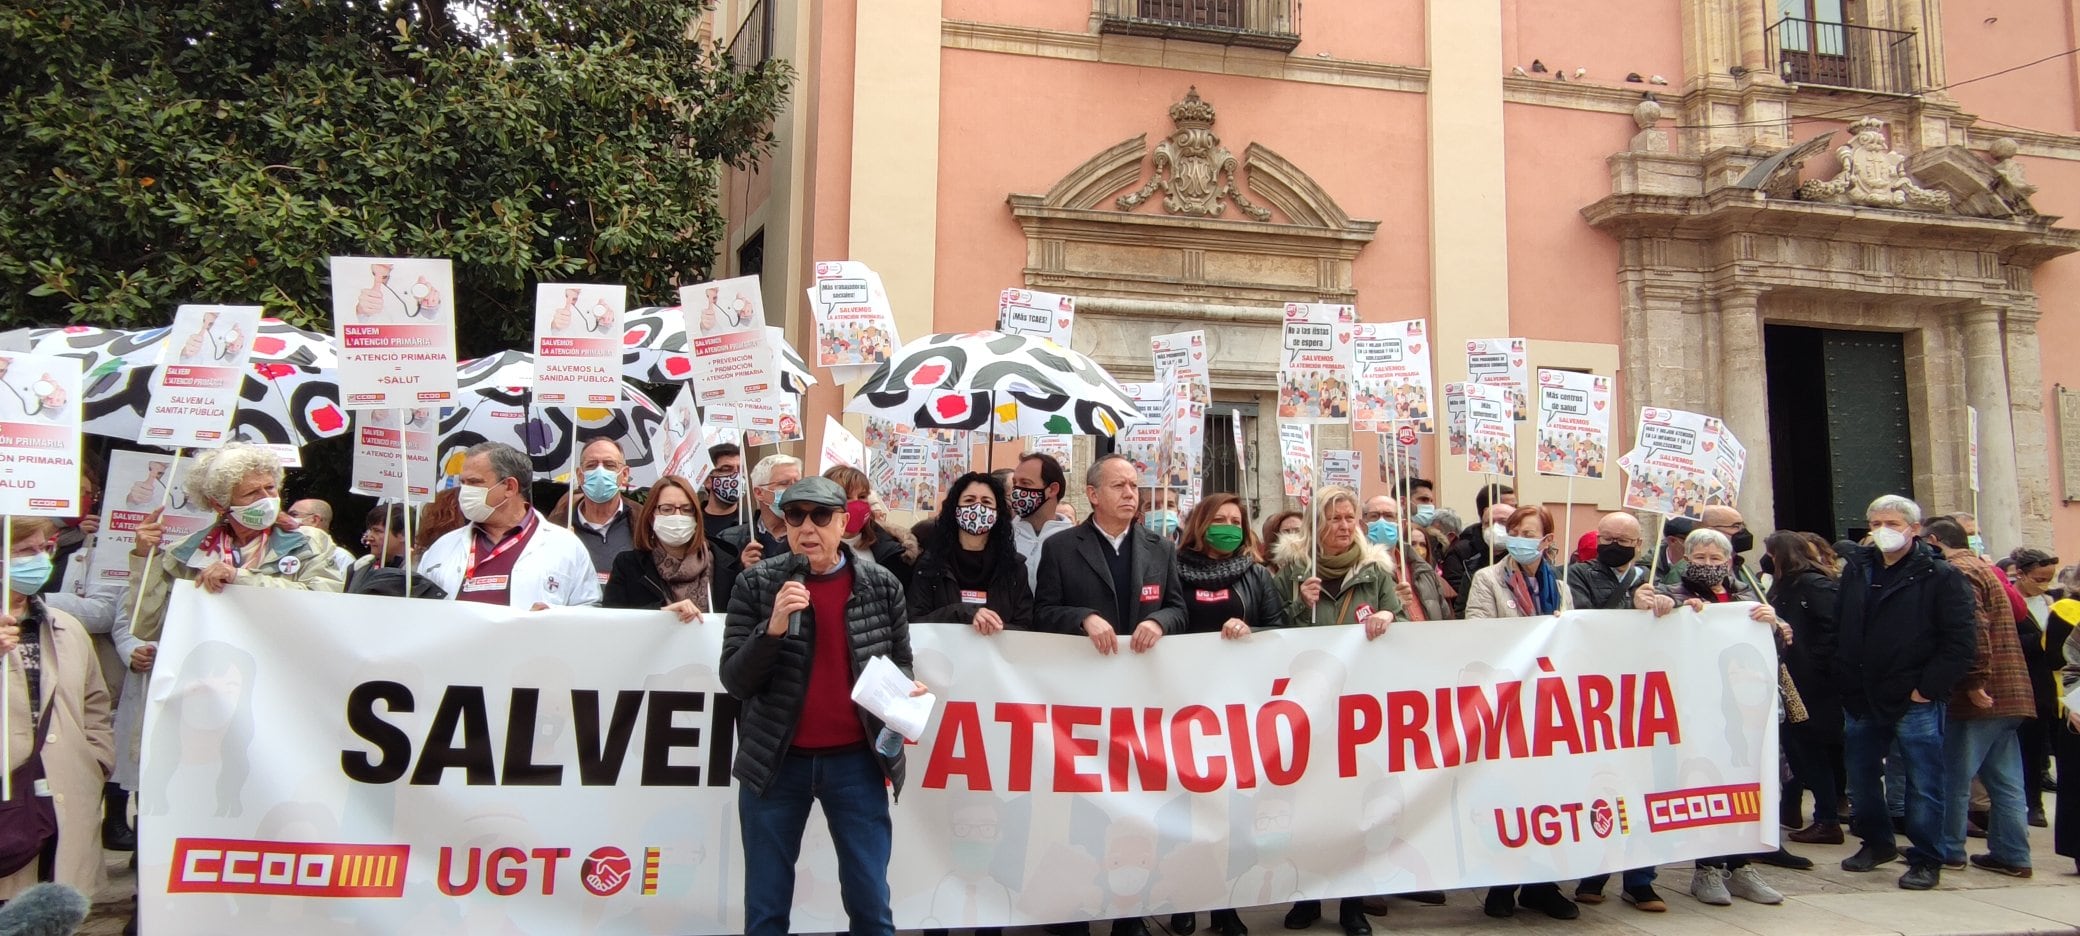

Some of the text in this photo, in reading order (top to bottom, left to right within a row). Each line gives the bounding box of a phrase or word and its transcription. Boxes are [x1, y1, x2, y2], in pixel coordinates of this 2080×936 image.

[1288, 326, 1295, 334] No
[1302, 327, 1311, 335] las
[1312, 327, 1329, 336] listas
[1302, 340, 1323, 348] espera
[1302, 354, 1334, 362] SALVEMOS
[546, 365, 592, 373] SALVEMOS
[170, 396, 215, 405] SALVEM LA
[1560, 393, 1583, 402] centros
[155, 406, 188, 415] SANITAT
[1551, 402, 1577, 412] de salud
[1559, 417, 1589, 425] SALVEMOS
[18, 455, 73, 465] PRIMARIA
[1660, 454, 1694, 465] SALVEMOS
[379, 470, 403, 478] +SALU
[1680, 465, 1705, 474] PRIMARIA
[0, 480, 36, 489] ALUD
[112, 512, 144, 521] SALVEM
[111, 522, 139, 530] L'ATEN
[921, 677, 1311, 793] ATENCIÓ
[1338, 656, 1681, 778] PRIMÀRIA
[1650, 793, 1732, 825] CCOO
[1493, 802, 1584, 849] UGT
[180, 849, 331, 887] CCOO
[437, 846, 571, 897] UGT
